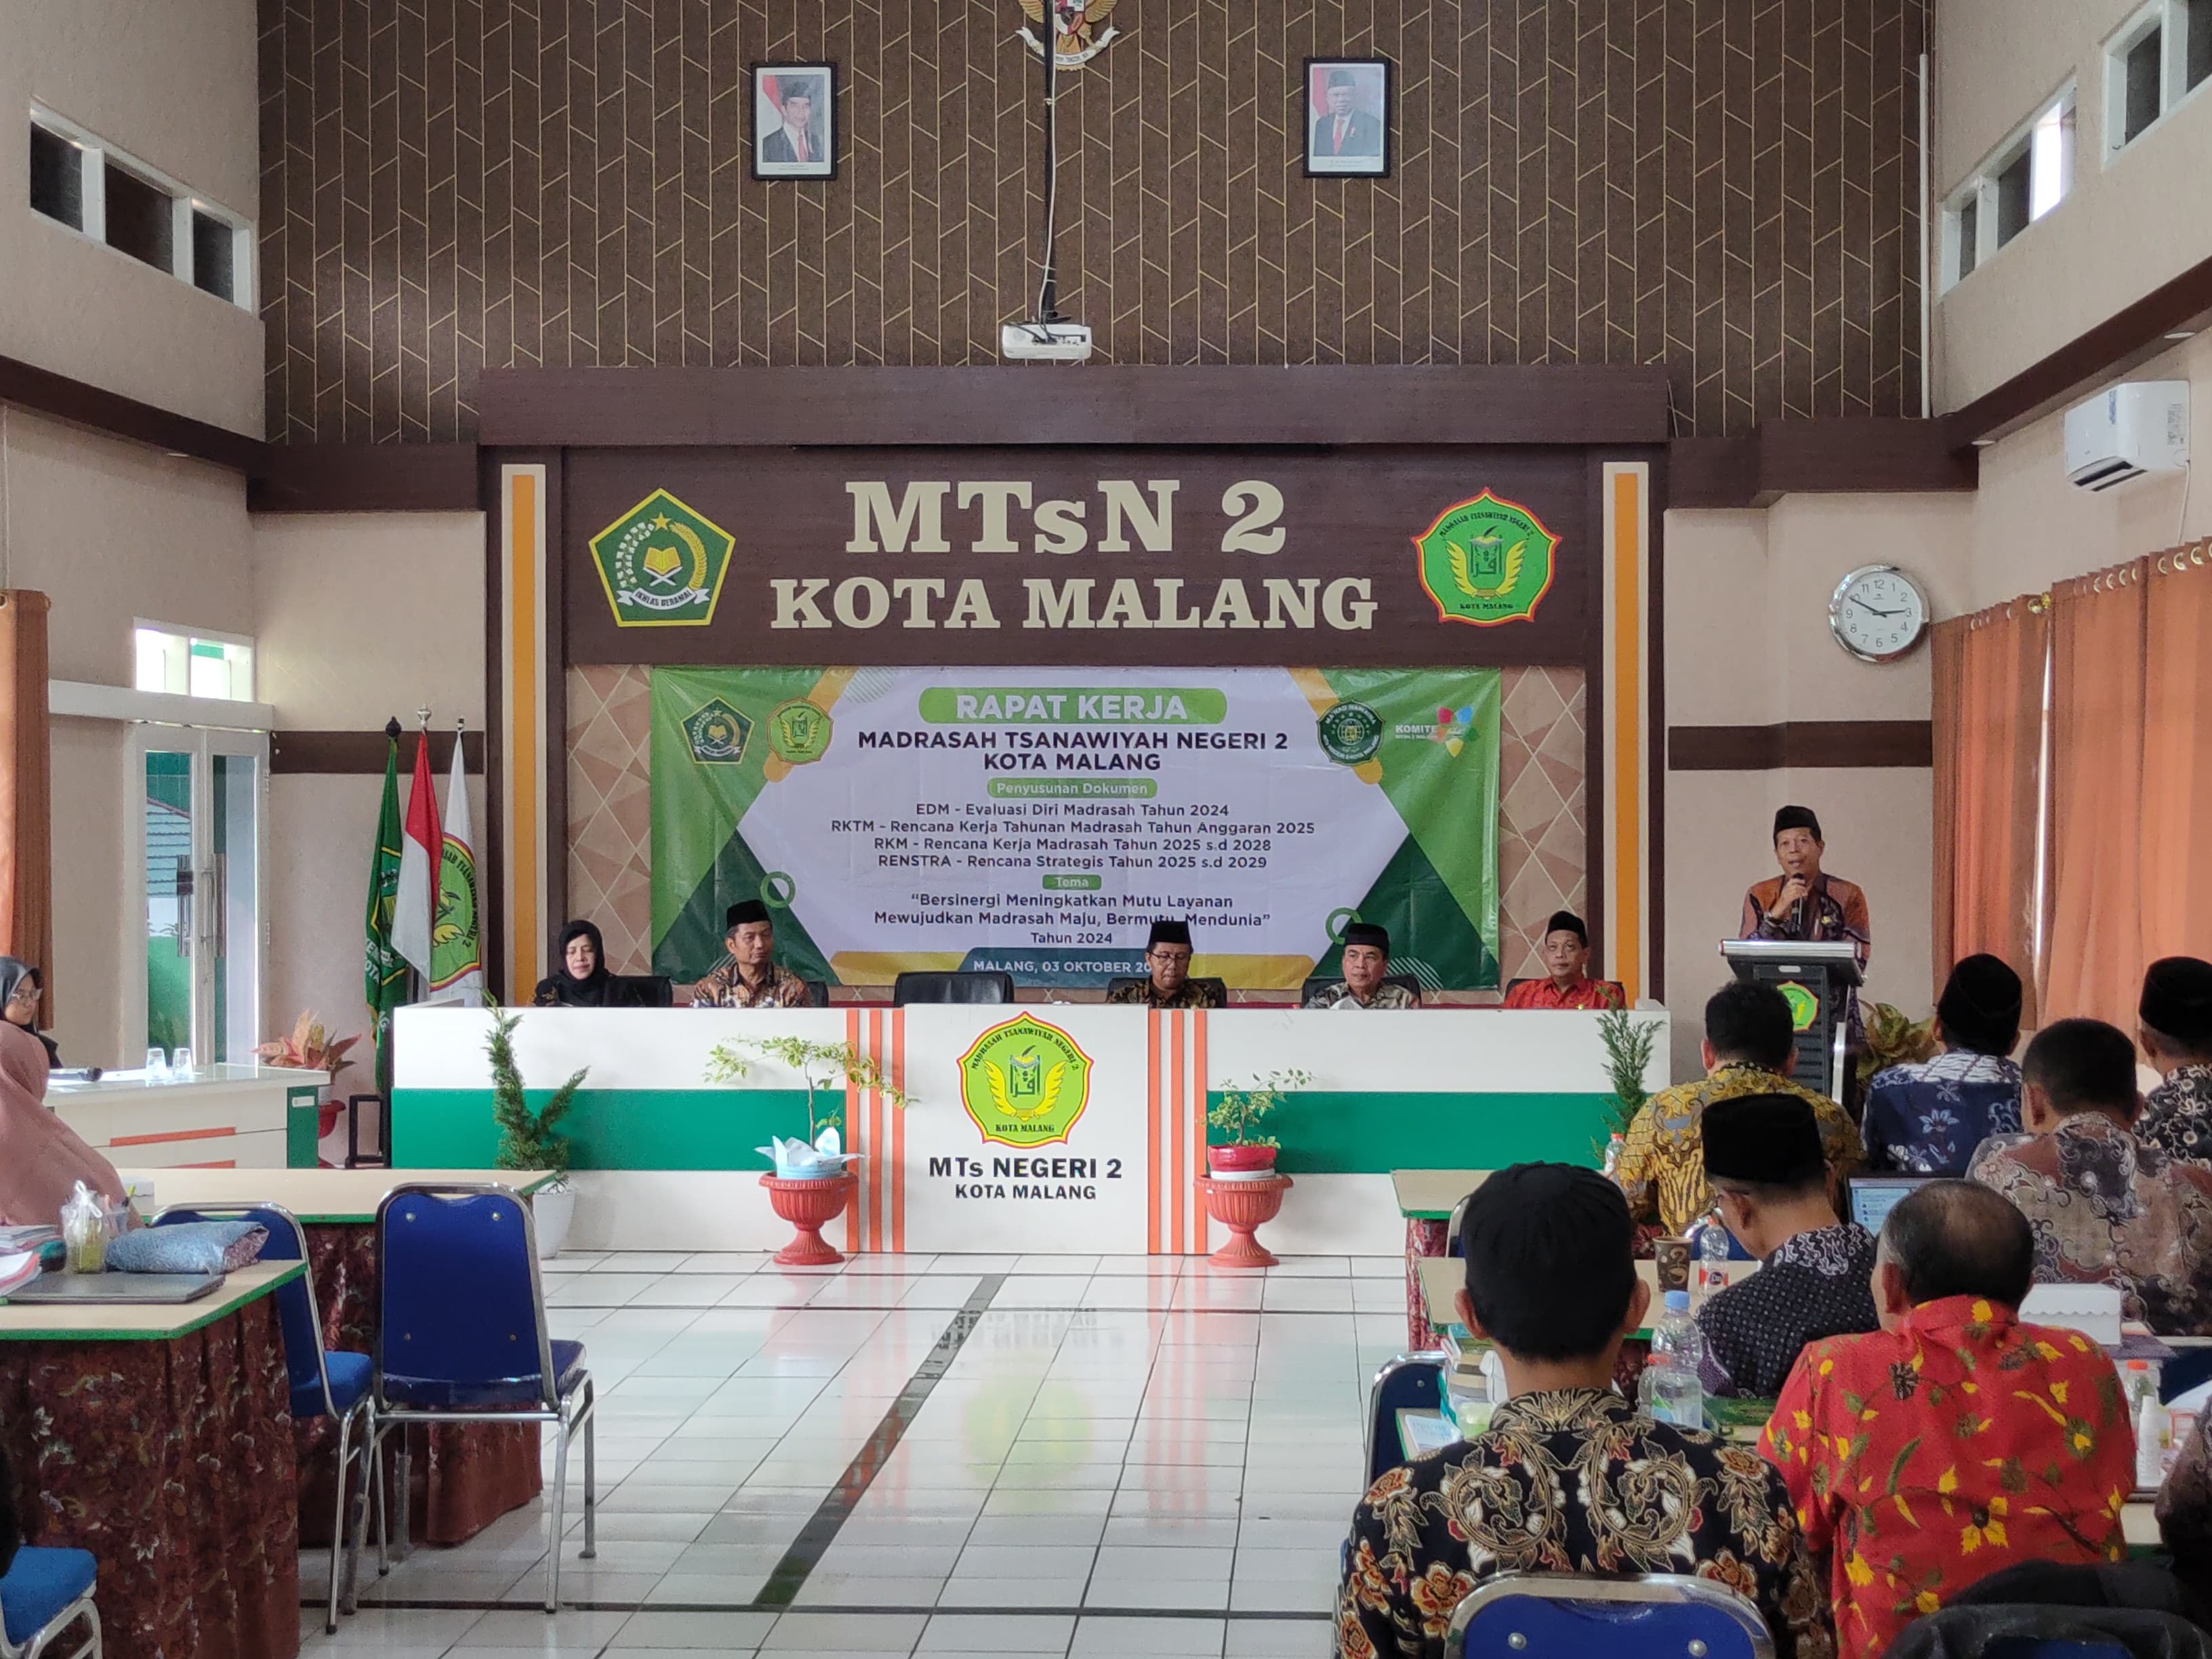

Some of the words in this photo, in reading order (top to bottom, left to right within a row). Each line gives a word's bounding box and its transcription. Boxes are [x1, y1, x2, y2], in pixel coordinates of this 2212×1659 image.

[846, 480, 1179, 554] MTsN
[1221, 480, 1286, 554] 2
[1874, 579, 1885, 590] 12
[771, 577, 1000, 628] KOTA
[1023, 577, 1378, 630] MALANG
[1900, 592, 1908, 602] 2
[1845, 609, 1853, 618] 9
[1904, 607, 1912, 617] 3
[1850, 623, 1857, 633] 8
[1900, 621, 1908, 631] 4
[1861, 634, 1868, 643] 7
[1876, 638, 1883, 647] 6
[1891, 633, 1898, 642] 5
[956, 695, 1067, 720] RAPAT
[1078, 695, 1188, 720] KERJA
[1395, 724, 1437, 733] KOMITE
[859, 732, 996, 749] MADRASAH
[1005, 732, 1168, 749] TSANAWIYAH
[1176, 733, 1266, 750] NEGERI
[1274, 733, 1288, 750] 2
[984, 754, 1047, 771] KOTA
[1056, 754, 1161, 771] MALANG
[997, 783, 1078, 797] Penyusunan
[1083, 783, 1148, 795] Dokumen
[916, 804, 949, 815] EDM
[966, 803, 1027, 815] Evaluasi
[1032, 803, 1059, 816] Diri
[1064, 804, 1135, 816] Madrasah
[1140, 804, 1185, 816] Tahun
[1190, 804, 1229, 816] 2024
[832, 821, 874, 832] RKTM
[890, 821, 954, 832] Rencana
[960, 821, 998, 834] Kerja
[1002, 821, 1065, 833] Tahunan
[1071, 821, 1142, 834] Madrasah
[1147, 821, 1192, 834] Tahun
[1197, 822, 1271, 836] Anggaran
[1276, 823, 1315, 834] 2025
[874, 838, 907, 849] RKM
[924, 838, 987, 850] Rencana
[993, 838, 1031, 852] Kerja
[1036, 838, 1108, 851] Madrasah
[1113, 838, 1158, 851] Tahun
[1162, 839, 1201, 851] 2025
[1206, 838, 1227, 851] s.d
[1233, 840, 1271, 851] 2028
[878, 855, 951, 867] RENSTRA
[968, 855, 1031, 867] Rencana
[1036, 855, 1104, 869] Strategis
[1109, 856, 1153, 868] Tahun
[1158, 857, 1196, 868] 2025
[1201, 856, 1223, 868] s.d
[1228, 857, 1267, 868] 2029
[1056, 877, 1089, 887] Tema
[912, 893, 1000, 909] “Bersinergi
[1006, 894, 1117, 909] Meningkatkan
[1122, 895, 1162, 907] Mutu
[1167, 895, 1233, 909] Layanan
[874, 912, 973, 926] Mewujudkan
[979, 912, 1054, 925] Madrasah
[1060, 912, 1101, 928] Maju,
[1030, 932, 1072, 944] Tahun
[1076, 933, 1112, 944] 2024
[974, 960, 1037, 973] MALANG,
[1042, 962, 1060, 972] 03
[1064, 962, 1131, 972] OKTOBER
[996, 1124, 1019, 1132] KOTA
[1021, 1124, 1054, 1132] MALANG
[929, 1157, 983, 1177] MTs
[994, 1158, 1097, 1179] NEGERI
[1107, 1158, 1122, 1179] 2
[956, 1185, 1006, 1199] KOTA
[1012, 1185, 1096, 1200] MALANG
